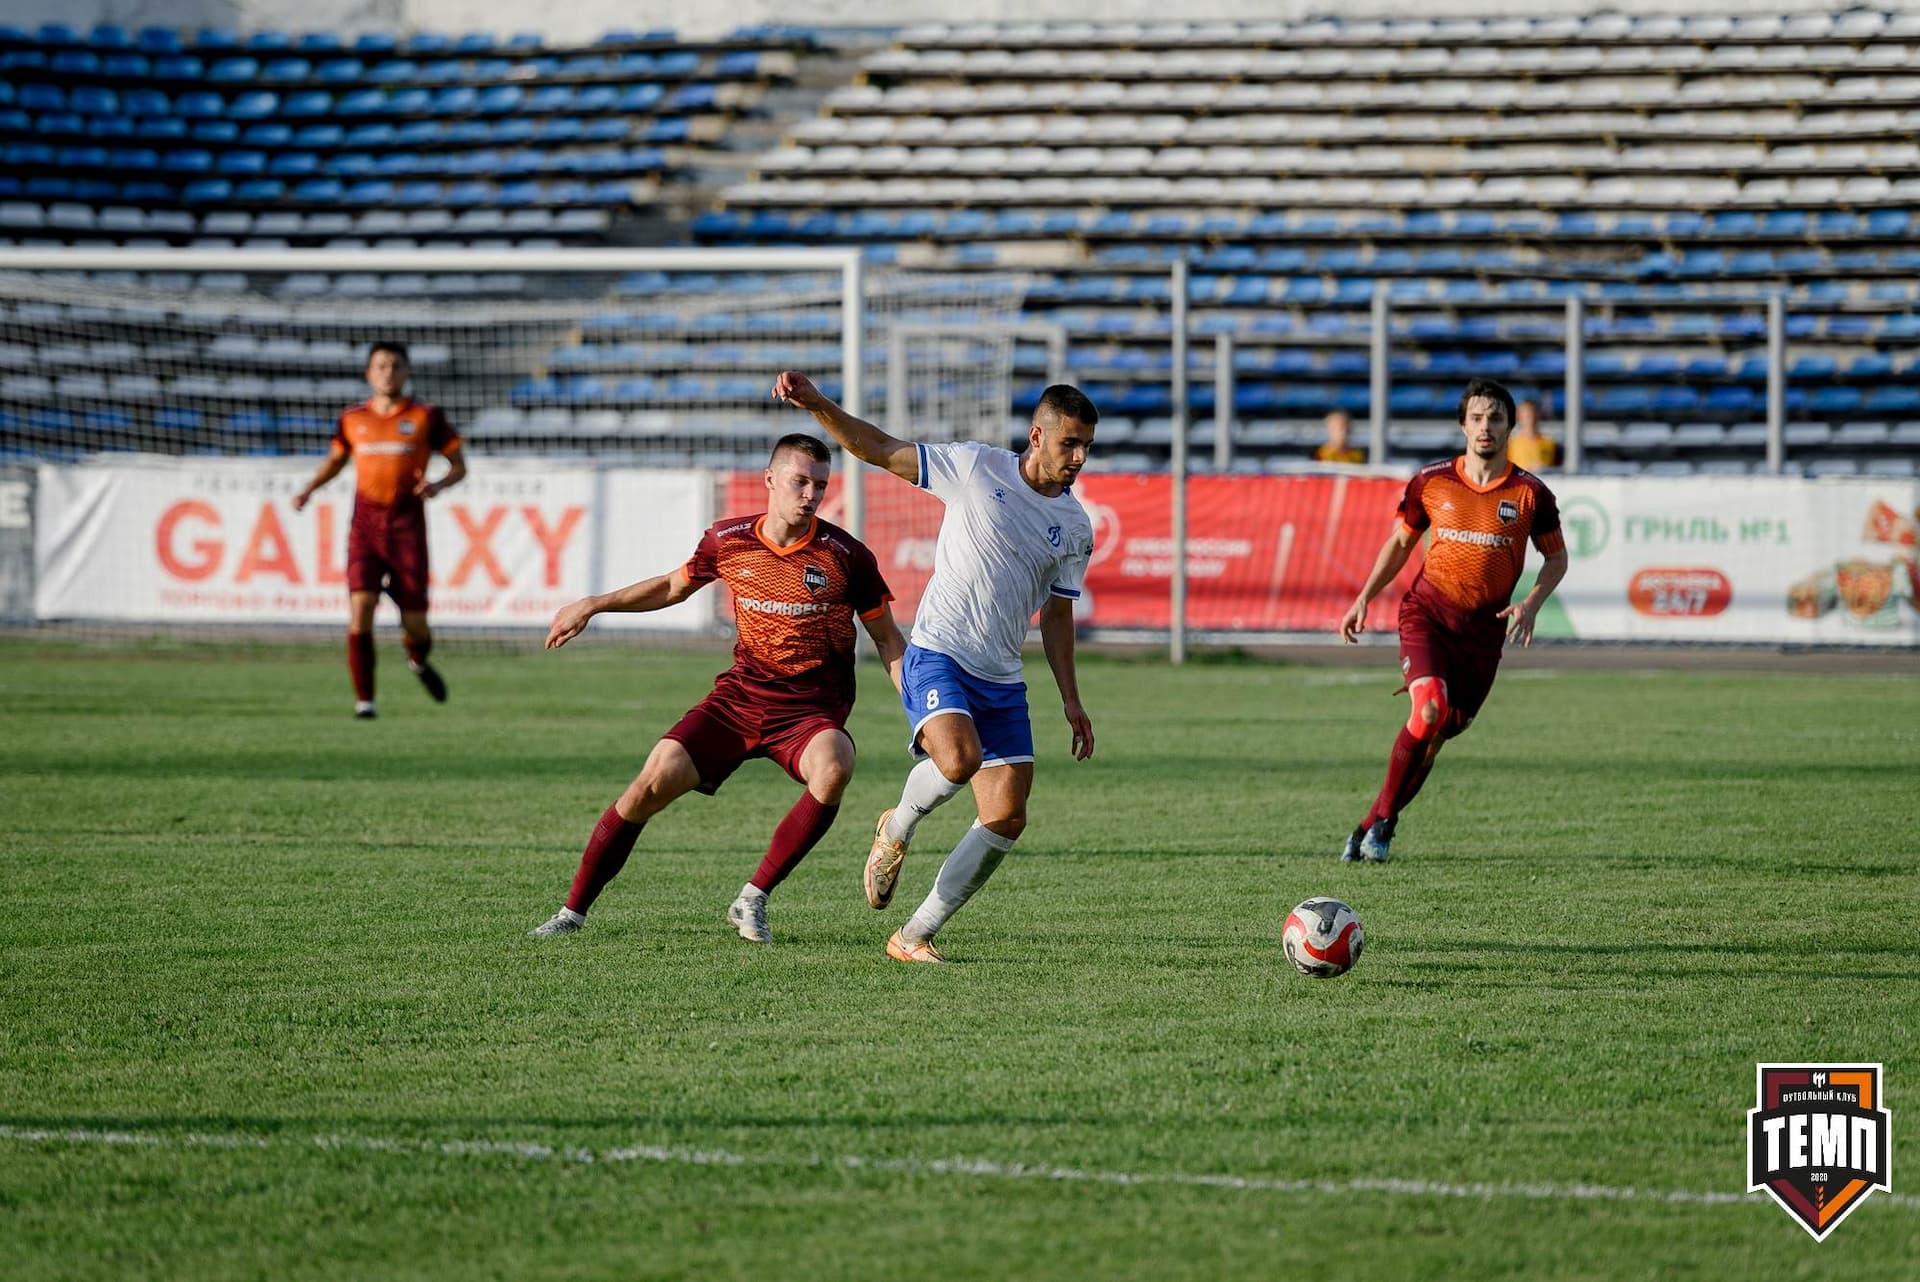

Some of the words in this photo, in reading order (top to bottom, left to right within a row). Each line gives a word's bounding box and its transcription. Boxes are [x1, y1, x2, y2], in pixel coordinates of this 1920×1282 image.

[1624, 515, 1729, 542] ГРИЛЬ
[155, 499, 584, 586] GALXY
[926, 688, 939, 710] 8
